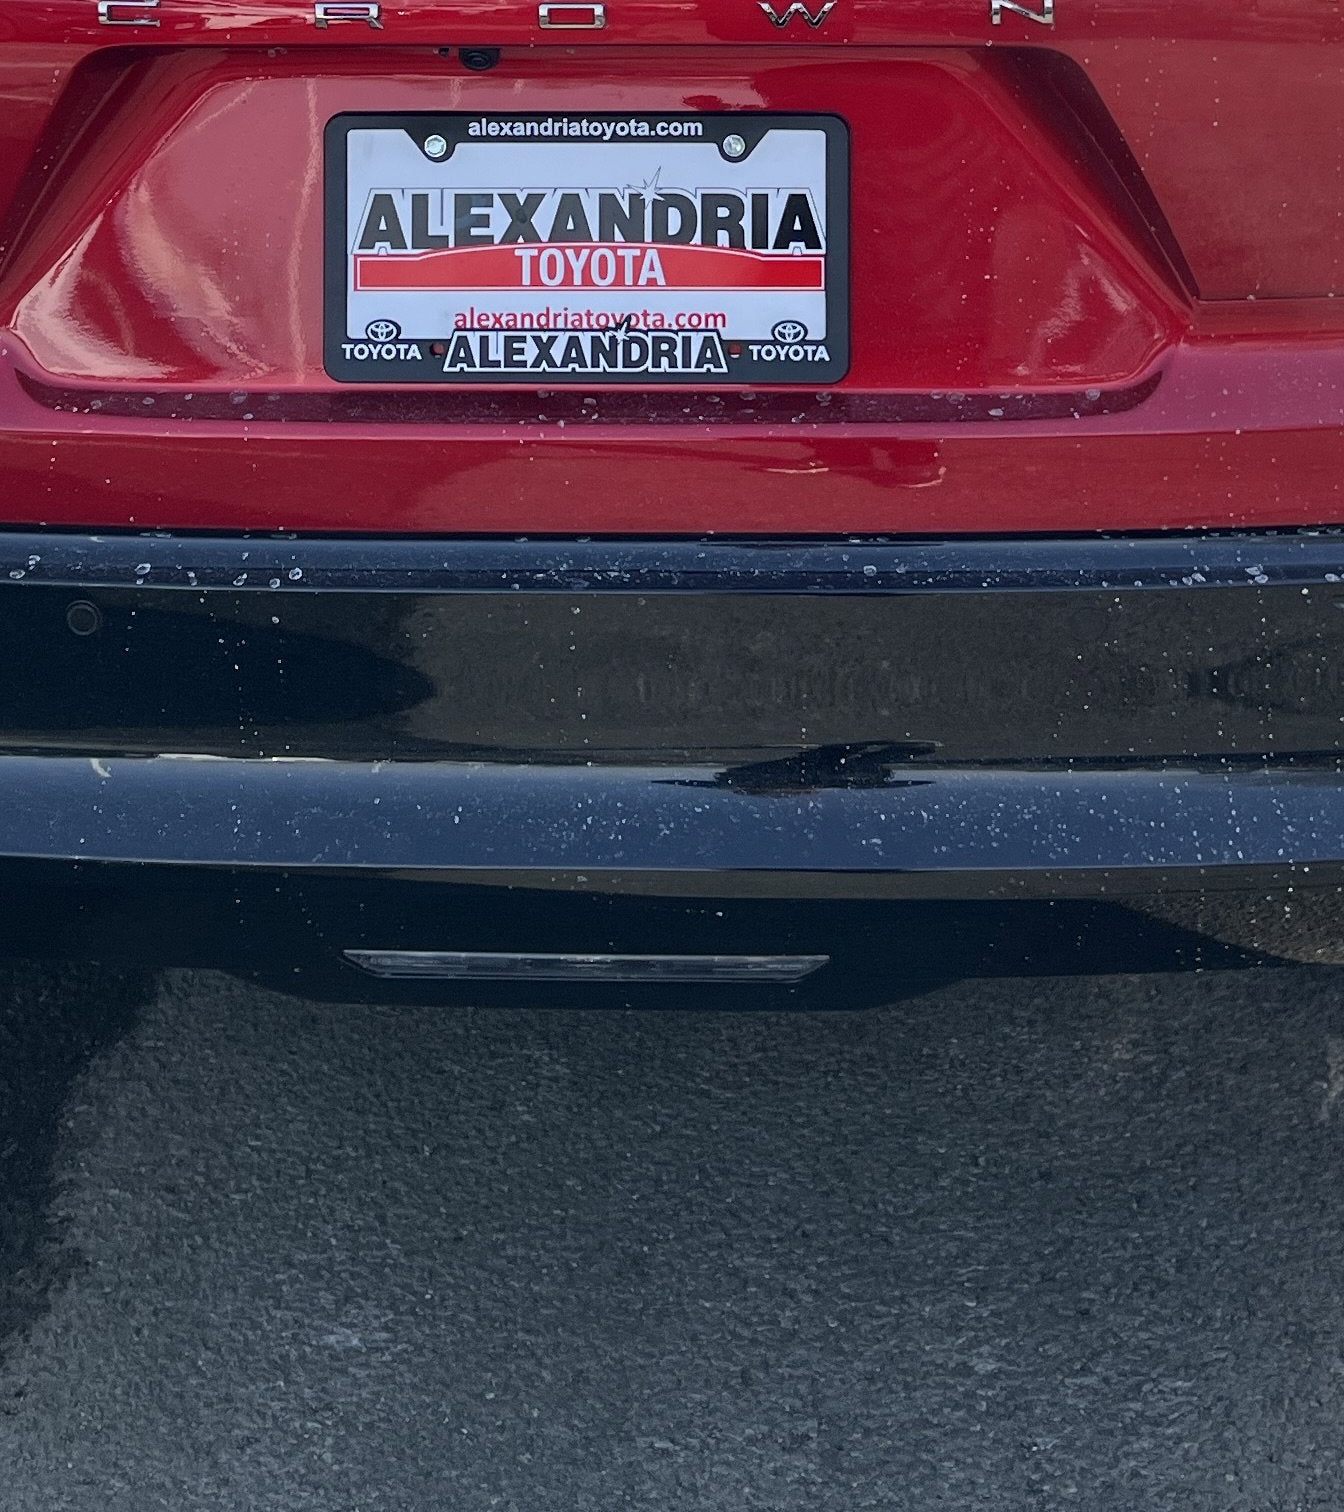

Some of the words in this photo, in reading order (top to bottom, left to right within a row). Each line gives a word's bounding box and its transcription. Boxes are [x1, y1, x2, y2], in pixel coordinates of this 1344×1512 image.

[467, 117, 704, 140] alexandriatoyota.com
[357, 190, 824, 251] ALEXANDRIA
[514, 247, 667, 287] TOYOTA
[453, 306, 727, 330] alexandriatoyota.com
[341, 343, 423, 360] TOYOTA
[445, 332, 726, 371] ALEXANDRIA
[749, 344, 830, 362] TOYOTA
